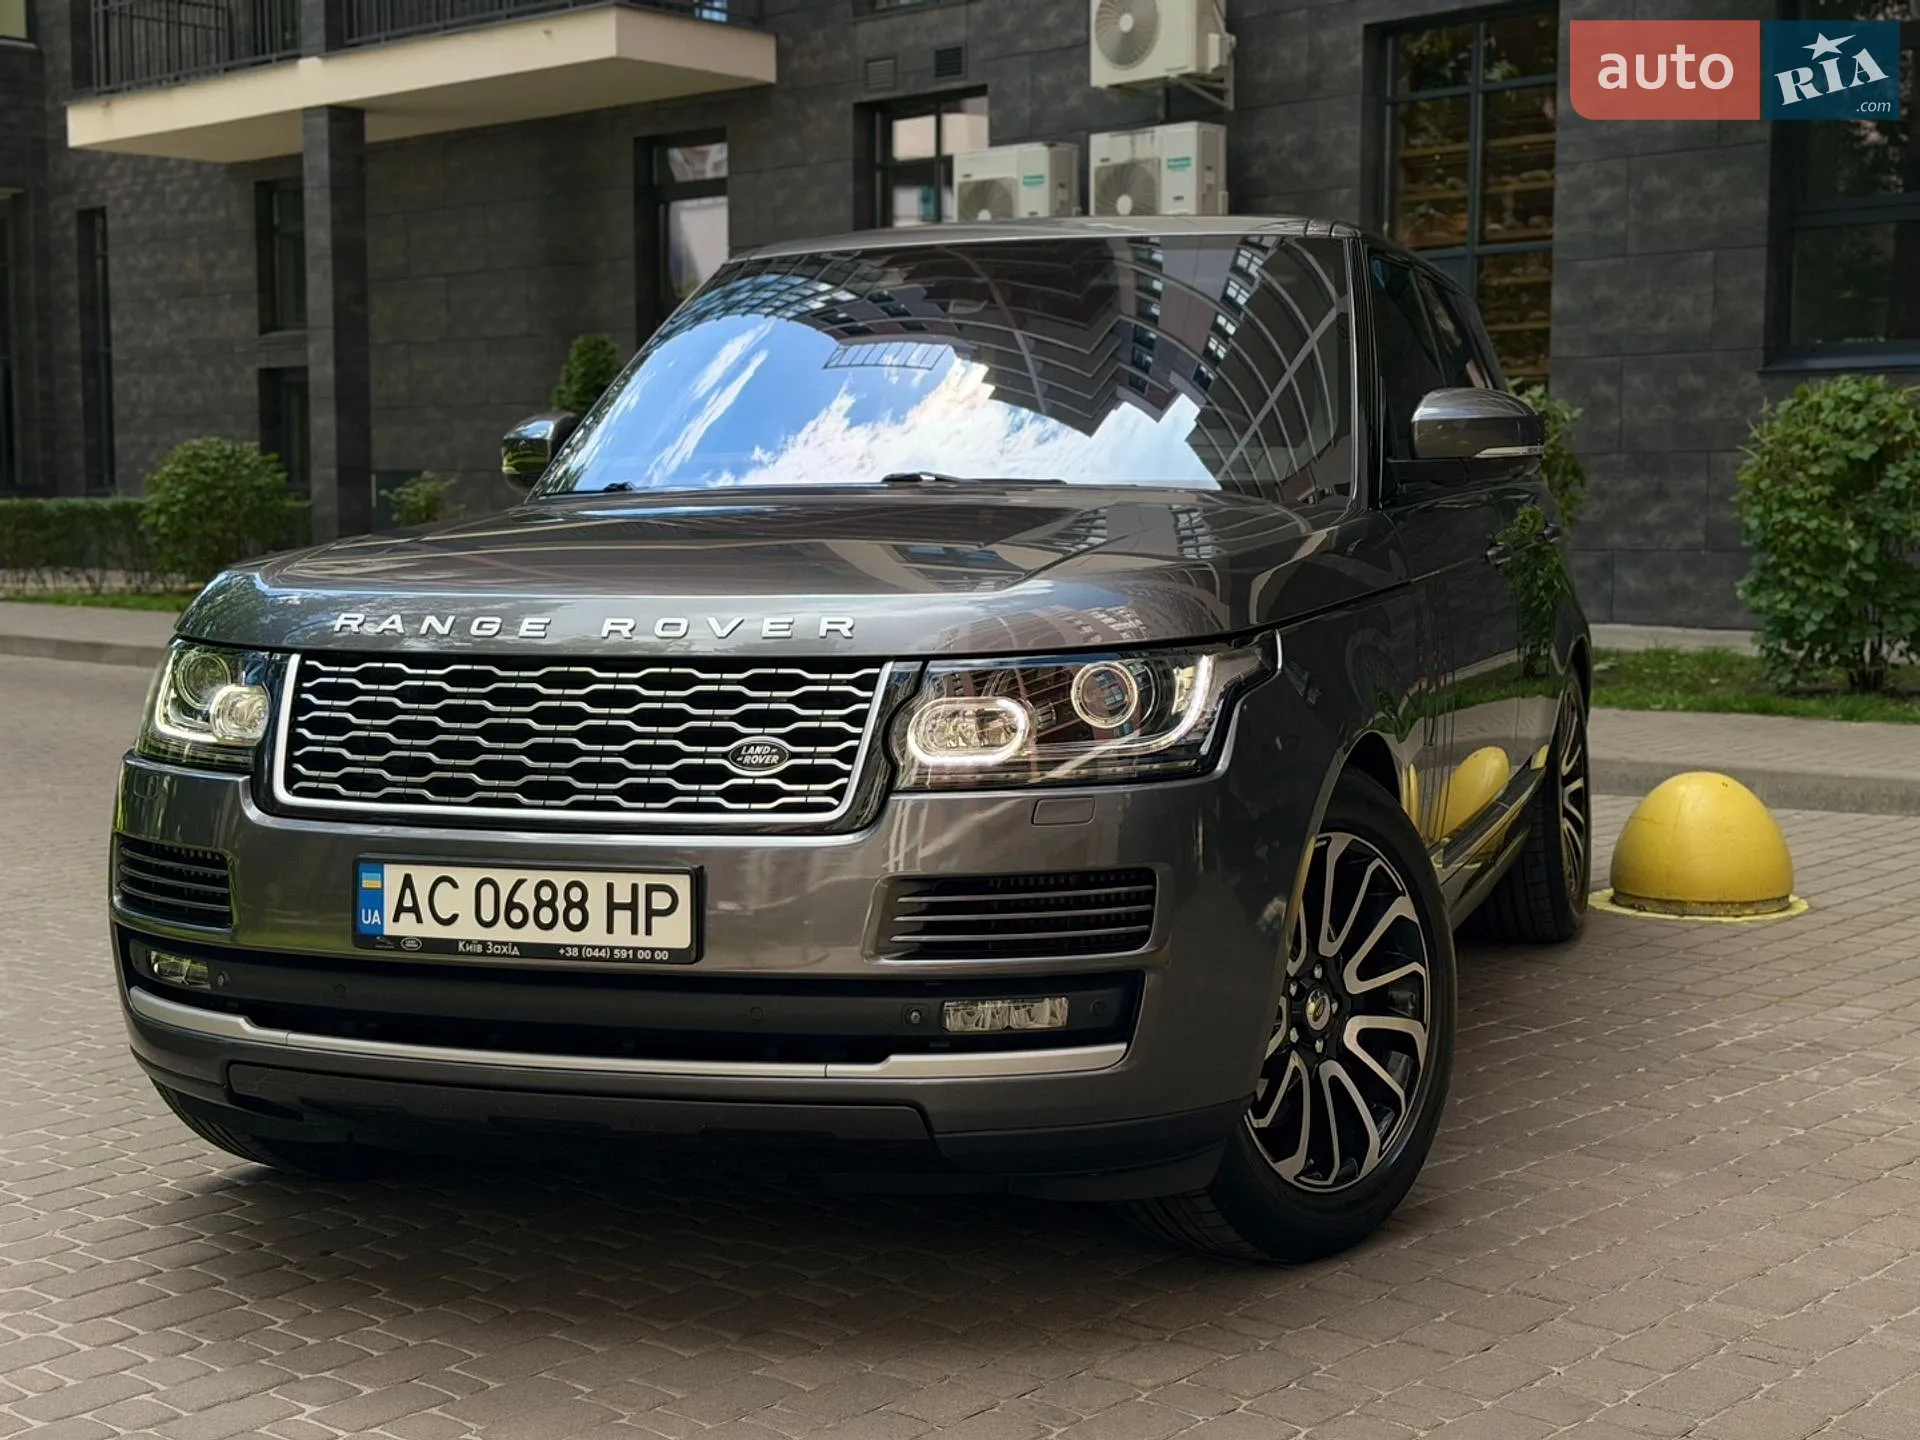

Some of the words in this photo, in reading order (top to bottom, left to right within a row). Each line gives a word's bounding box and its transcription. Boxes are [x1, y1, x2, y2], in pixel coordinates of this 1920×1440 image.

[333, 612, 551, 639] RANGE
[601, 617, 856, 639] ROVER
[392, 873, 460, 927] AC
[474, 877, 589, 933] 0688
[606, 882, 680, 937] HP
[362, 909, 381, 925] UA
[458, 939, 482, 953] Київ
[486, 942, 520, 956] Захід
[559, 947, 578, 957] +38
[582, 947, 610, 959] (044)
[614, 949, 633, 959] 591
[637, 950, 651, 960] 00
[655, 950, 669, 960] 00
